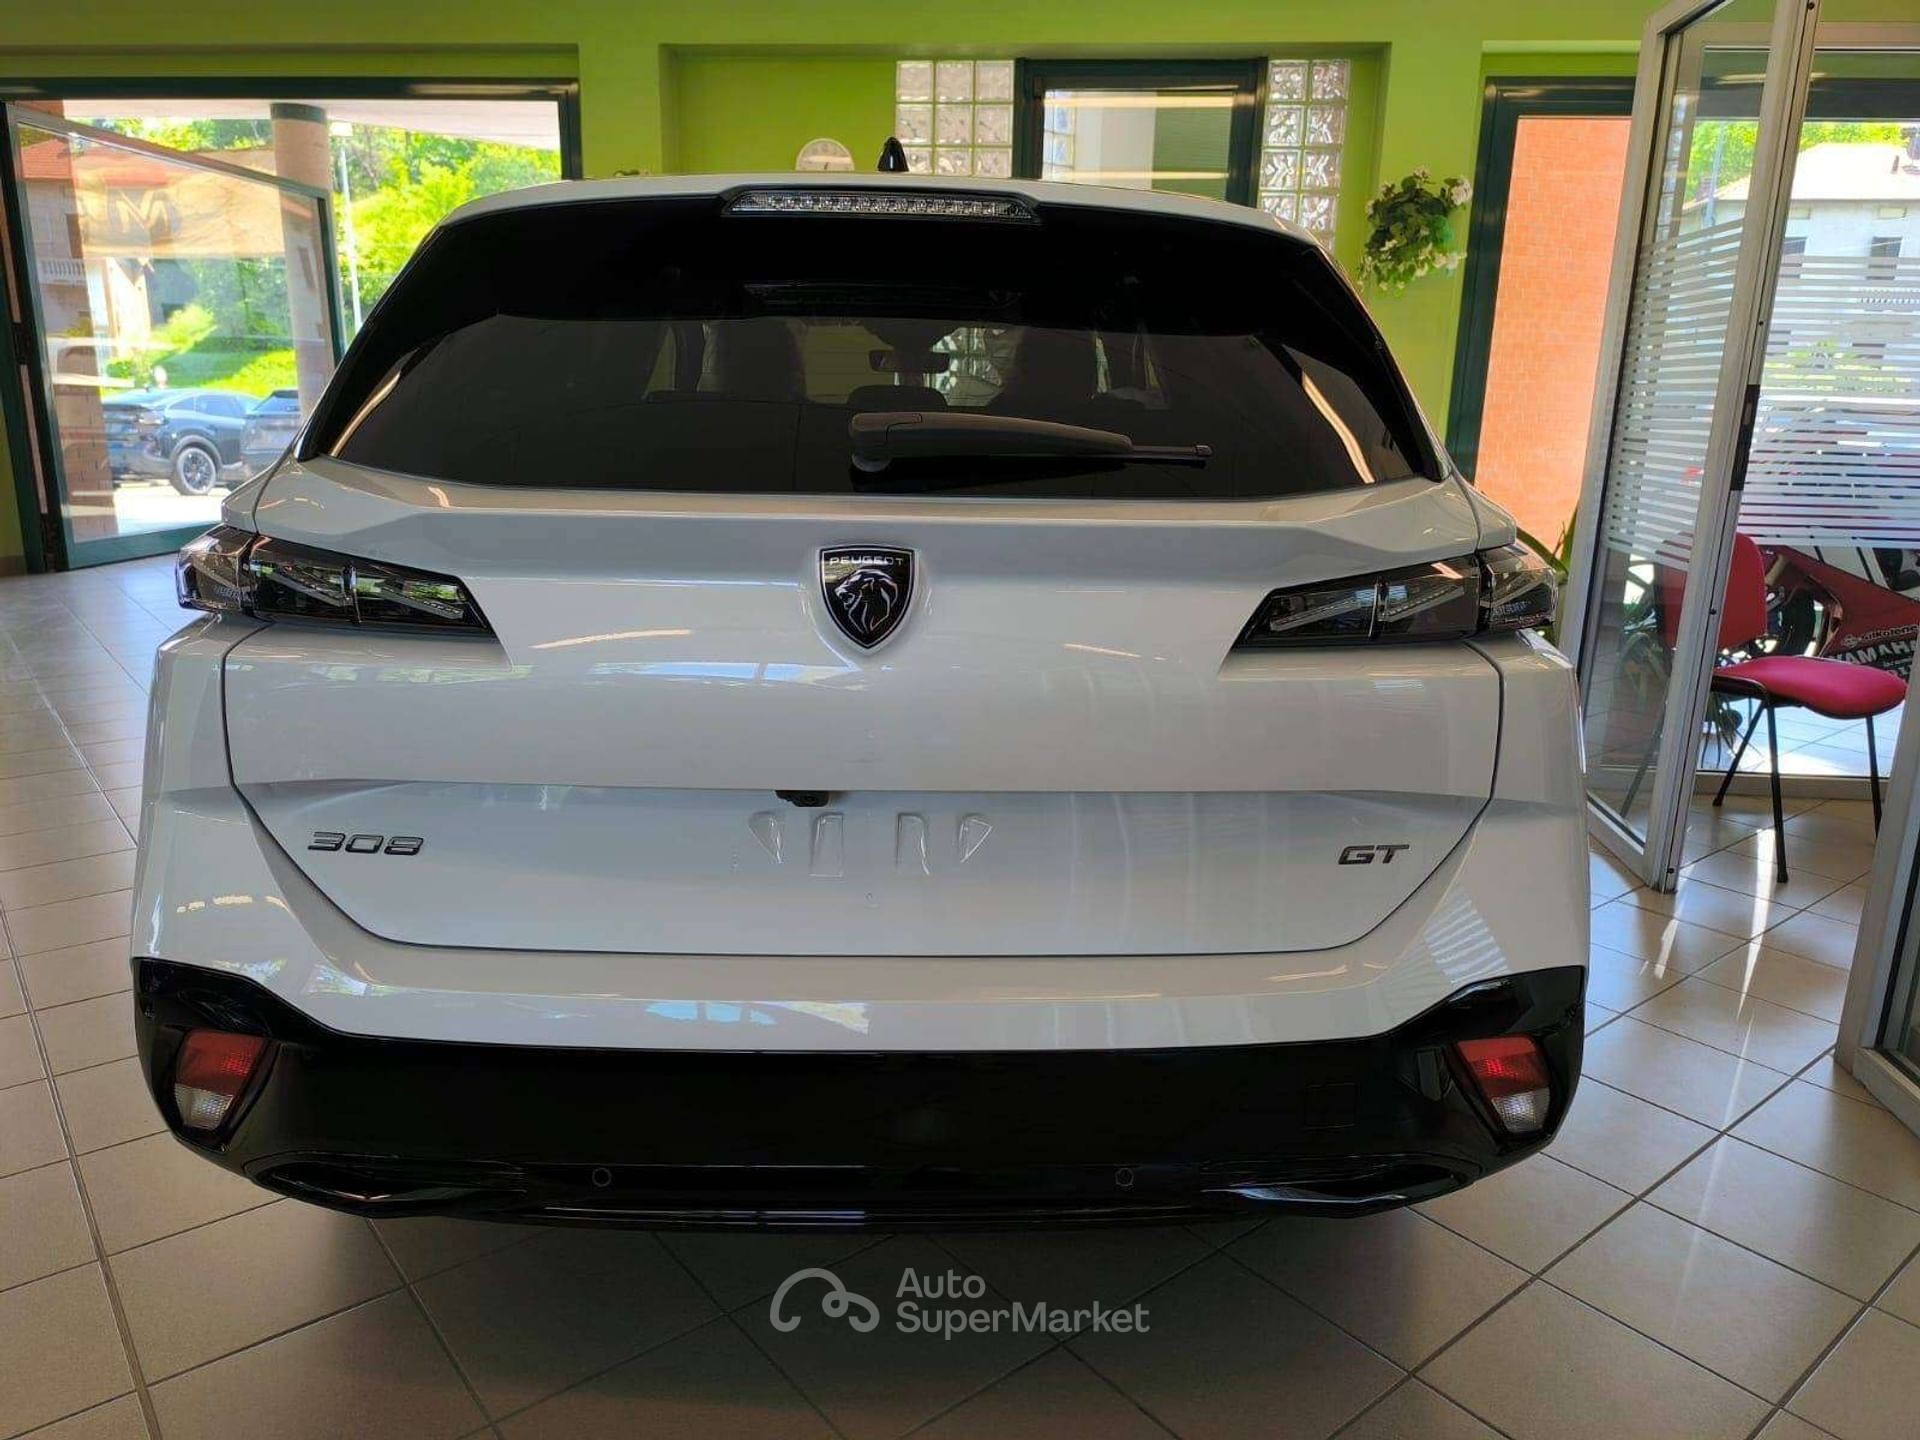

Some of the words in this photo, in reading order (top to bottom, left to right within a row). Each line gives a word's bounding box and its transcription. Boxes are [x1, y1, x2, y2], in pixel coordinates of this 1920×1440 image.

[829, 555, 904, 567] PEUGEOT
[308, 831, 424, 856] 308
[1338, 844, 1410, 865] GT
